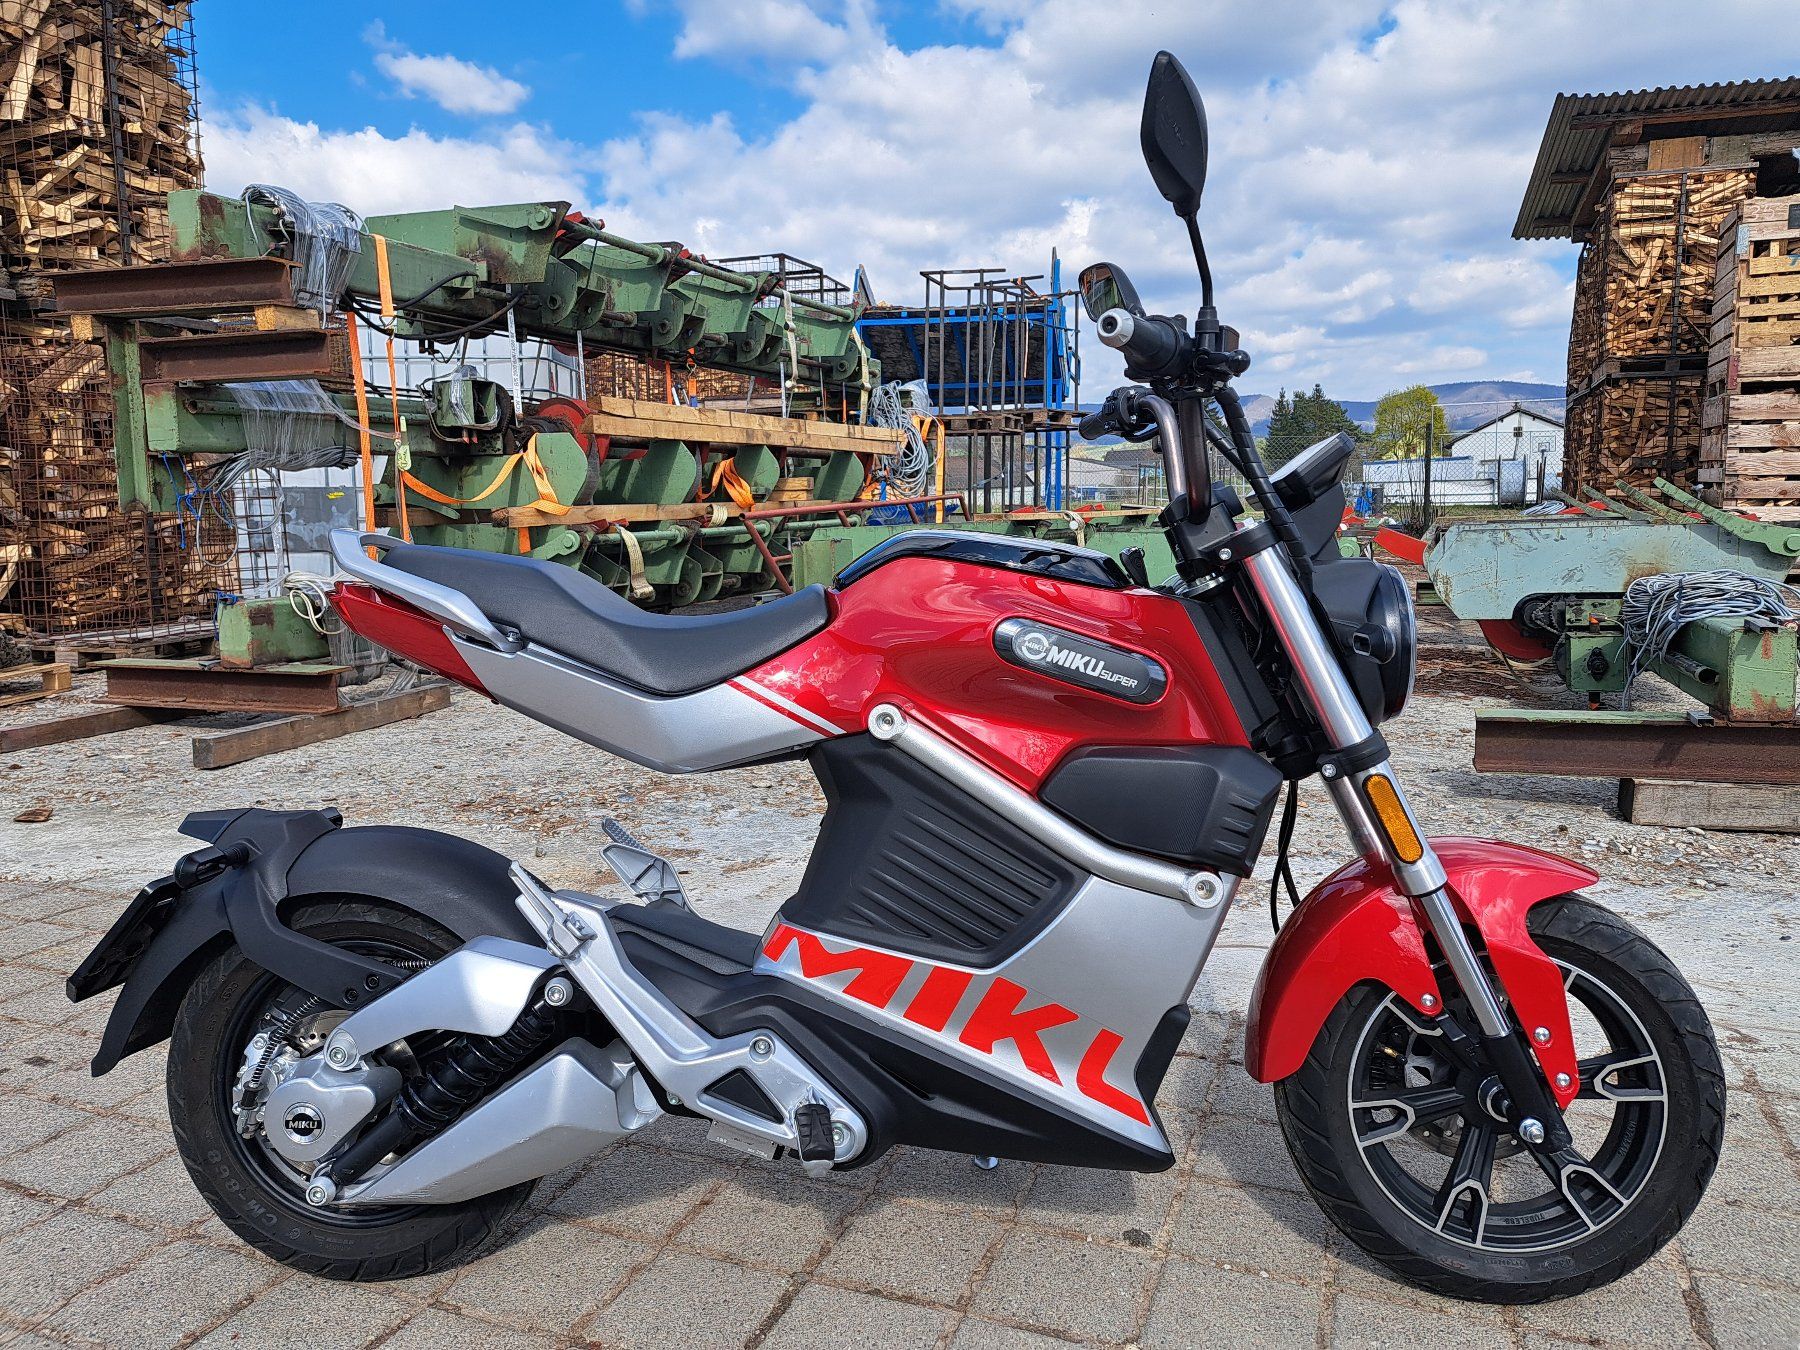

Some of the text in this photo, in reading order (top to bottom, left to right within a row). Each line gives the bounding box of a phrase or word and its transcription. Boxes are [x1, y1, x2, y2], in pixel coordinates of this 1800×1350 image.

[1024, 640, 1047, 654] MIKU
[1046, 645, 1138, 689] MIKU SUPER
[288, 1120, 318, 1129] MIKU
